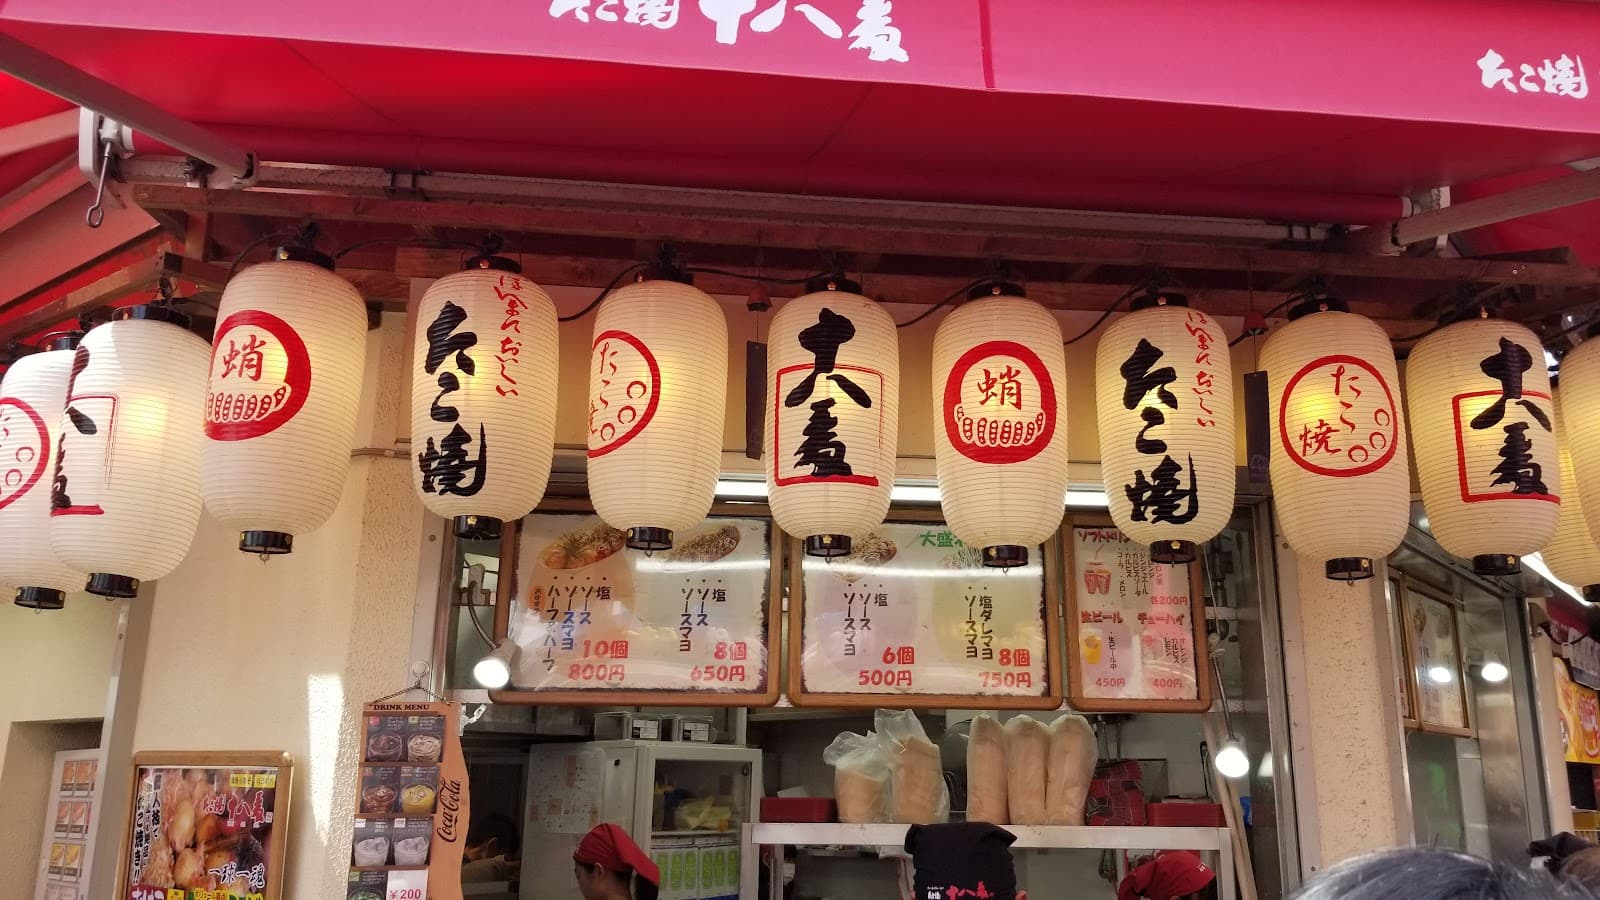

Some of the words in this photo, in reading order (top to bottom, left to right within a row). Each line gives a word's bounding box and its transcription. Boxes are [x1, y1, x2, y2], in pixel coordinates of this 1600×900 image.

[1477, 49, 1588, 98] たこ焼
[419, 301, 487, 496] たこ焼
[1120, 338, 1199, 524] たこ焼
[1078, 530, 1131, 543] ソフトドリン
[596, 586, 612, 600] 塩
[712, 588, 727, 602] 塩
[874, 593, 888, 607] 塩
[580, 586, 594, 625] ソース
[697, 588, 709, 626] ソース
[859, 593, 872, 630] ソース
[561, 586, 577, 650] ソースマヨ
[680, 588, 693, 651] ソースマヨ
[843, 592, 855, 656] ソースマヨ
[964, 595, 978, 658] ソースマヨ
[1080, 610, 1124, 624] 生ビール
[1137, 612, 1185, 626] チューハイ
[583, 639, 628, 659] 10個
[714, 641, 747, 660] 8個
[882, 646, 915, 665] 6個
[998, 648, 1031, 667] 8個
[568, 664, 625, 681] 800円
[690, 664, 746, 682] 650円
[858, 669, 913, 687] 500円
[979, 671, 1032, 688] 750円
[1096, 677, 1126, 688] 450円
[404, 703, 430, 711] MENU
